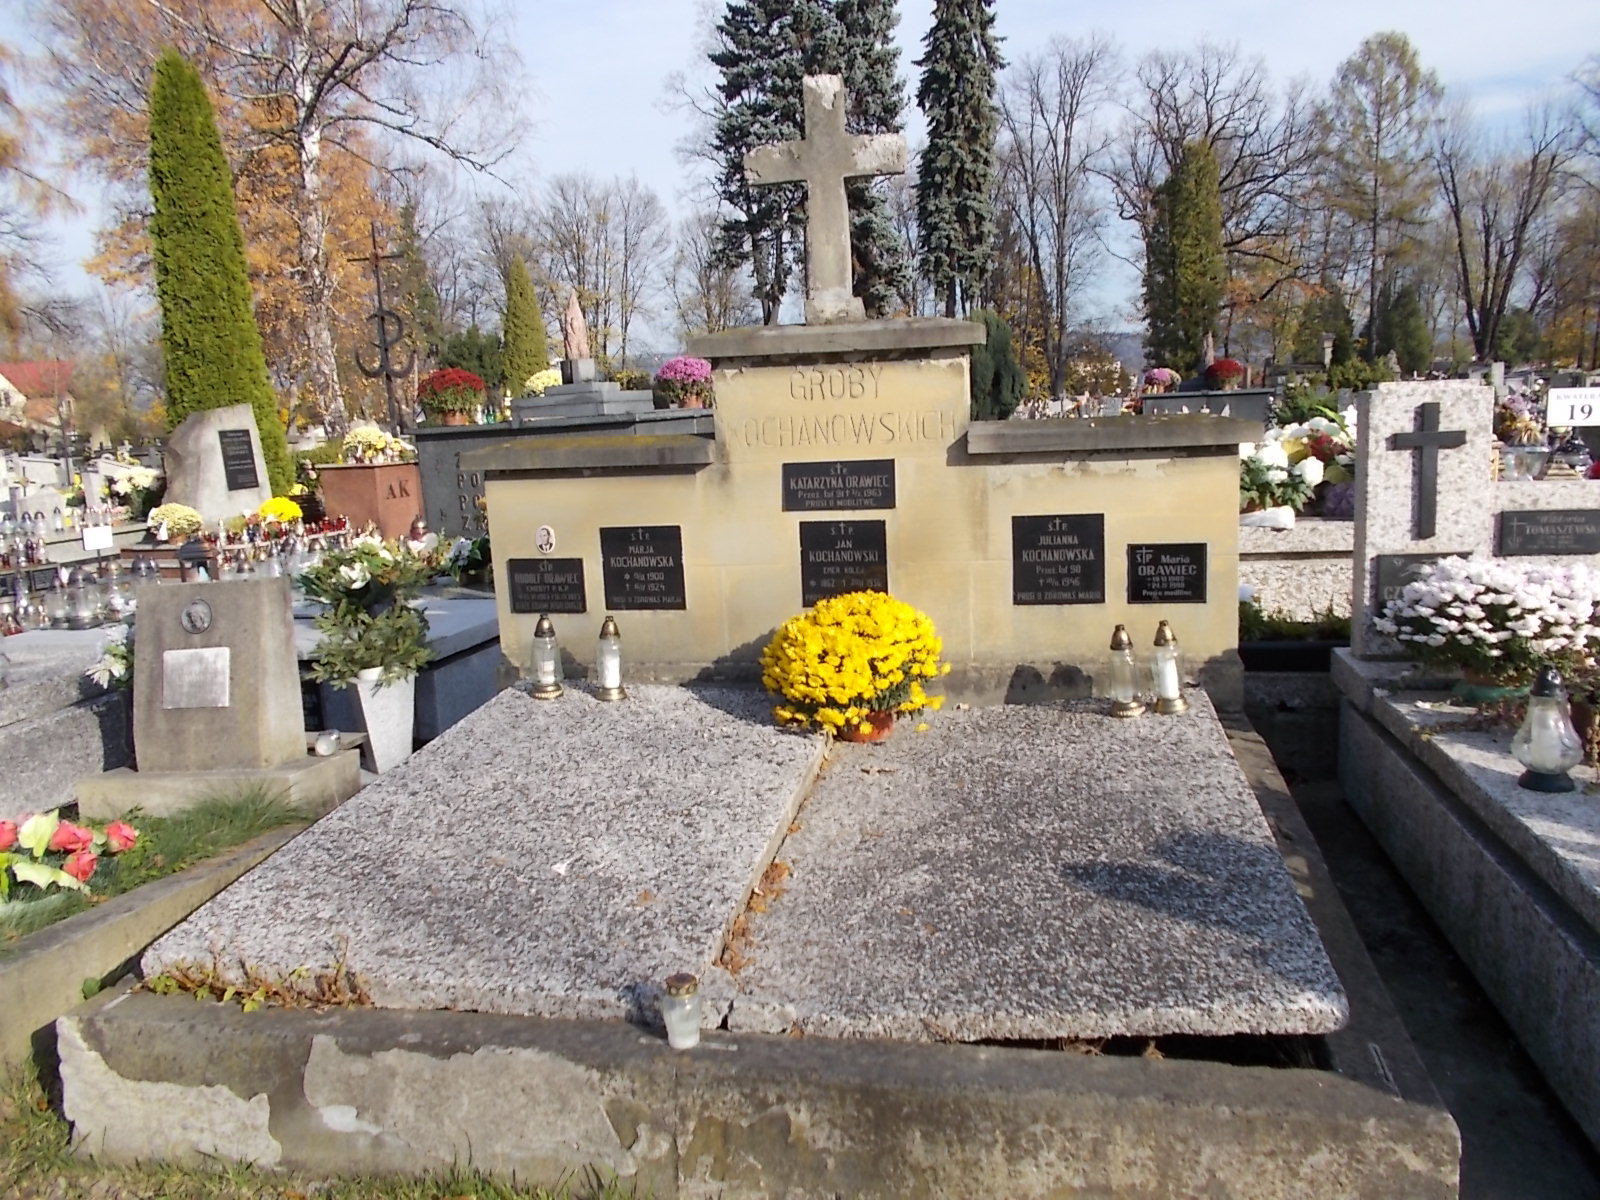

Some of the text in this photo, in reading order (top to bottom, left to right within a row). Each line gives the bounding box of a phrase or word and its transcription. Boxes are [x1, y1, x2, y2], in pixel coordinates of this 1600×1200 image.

[789, 365, 883, 400] GROBY
[1568, 403, 1593, 420] 19
[789, 475, 890, 490] KATARZYNA ORAWIEC
[386, 479, 410, 500] AK
[834, 540, 853, 549] JAN
[1038, 534, 1079, 546] JULIANNA
[628, 545, 655, 554] MARJA
[1022, 548, 1095, 562] KOCHANOWSKA
[610, 555, 675, 568] KOCHANOWSKA
[809, 550, 879, 562] KOCHANOWSKI
[1160, 554, 1191, 564] Maria
[1138, 564, 1197, 576] ORAWIEC
